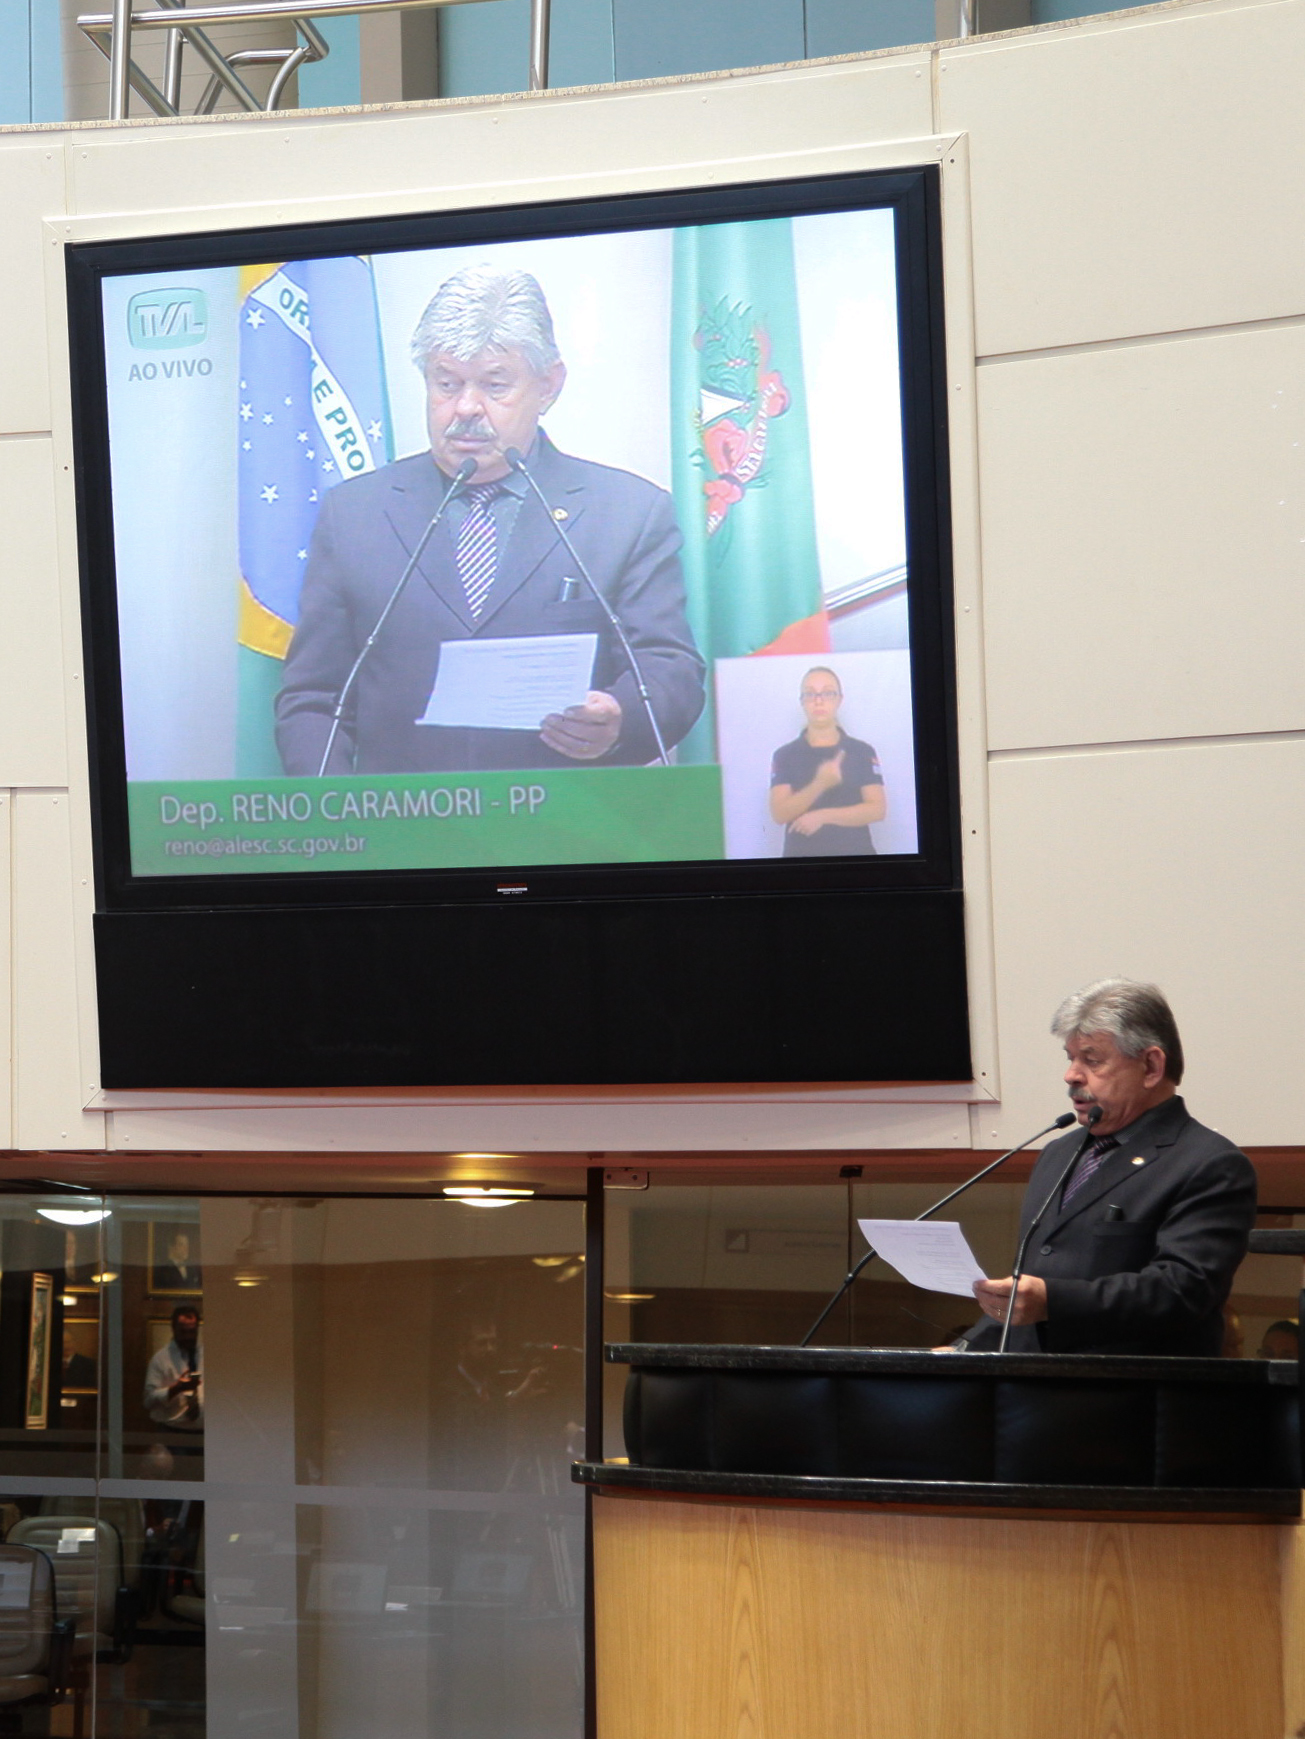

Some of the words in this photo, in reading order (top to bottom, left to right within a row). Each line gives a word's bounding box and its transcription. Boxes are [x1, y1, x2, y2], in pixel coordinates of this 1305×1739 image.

[128, 361, 157, 381] AO
[161, 358, 213, 380] VIVO
[160, 795, 224, 829] Dep.
[233, 792, 311, 822] RENO
[320, 787, 481, 821] CARAMORI
[509, 784, 546, 815] PP
[164, 832, 366, 858] reno@alesc.sc.gov.br
